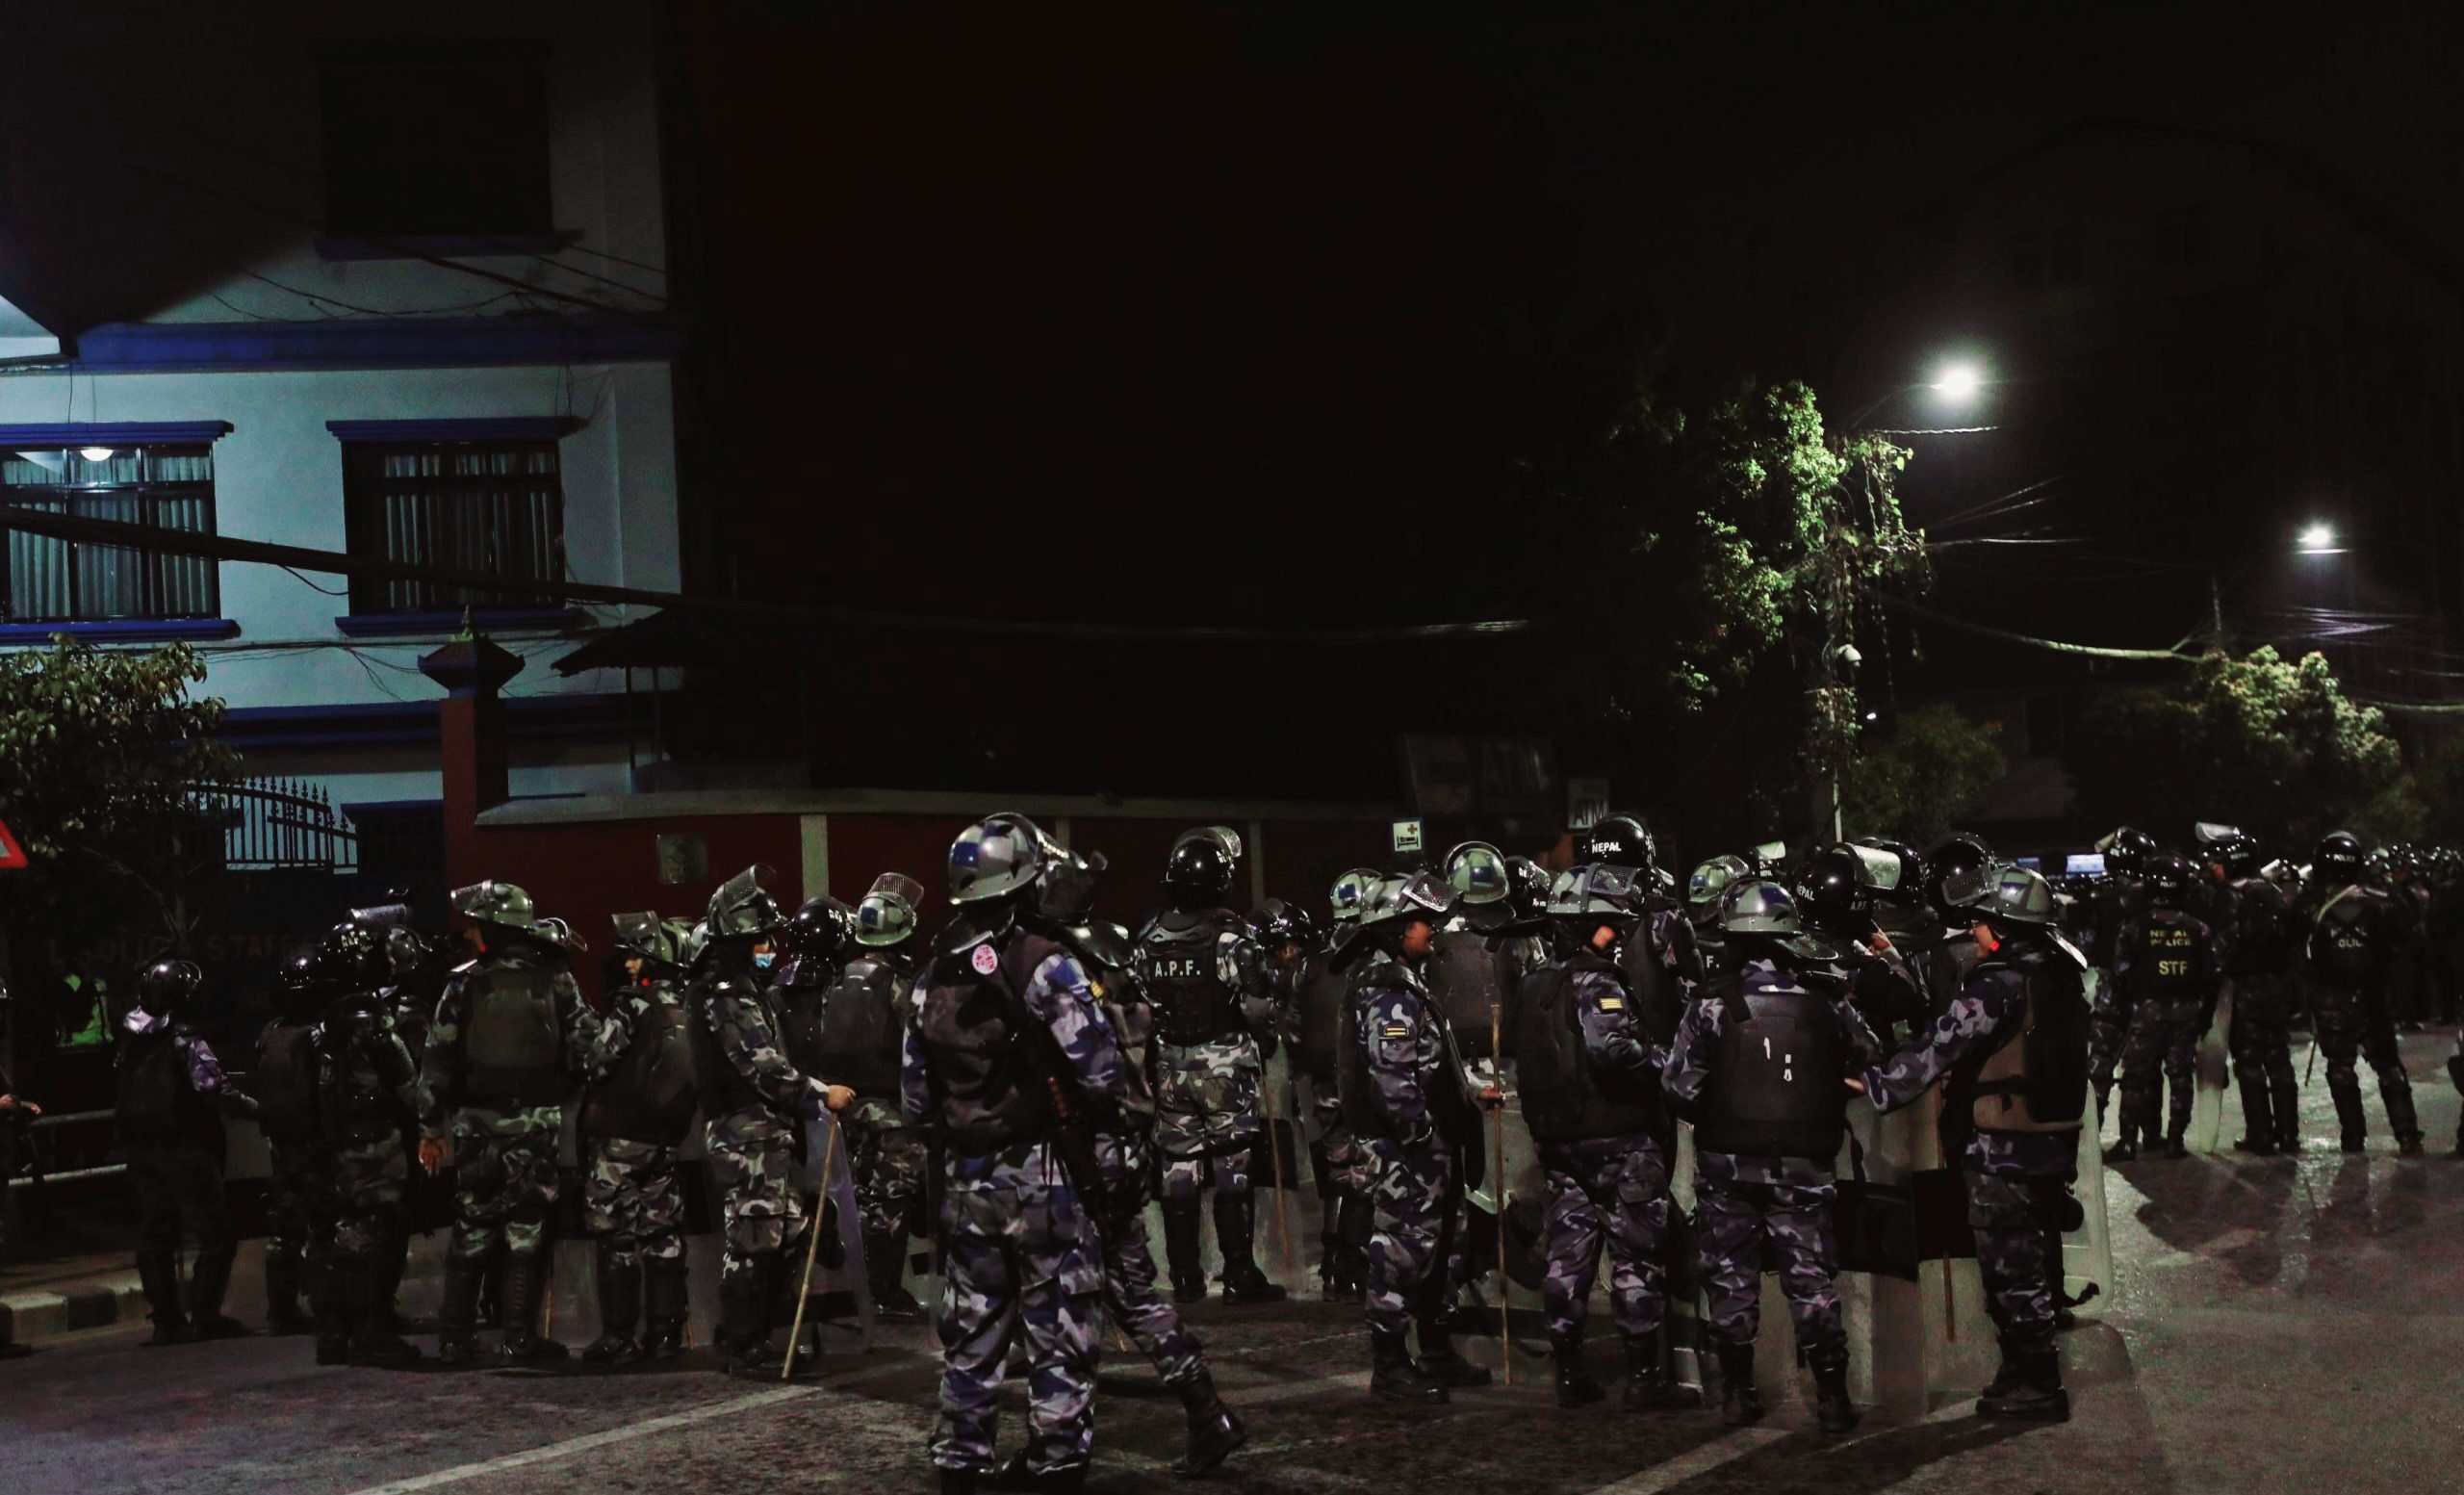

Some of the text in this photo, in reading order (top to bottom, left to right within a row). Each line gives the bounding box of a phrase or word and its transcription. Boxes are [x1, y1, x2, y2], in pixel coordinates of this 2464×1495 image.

[1573, 799, 1606, 827] ATM
[1591, 841, 1622, 854] NEPAL
[1154, 959, 1201, 978] A.P.F.
[2158, 961, 2188, 975] STF
